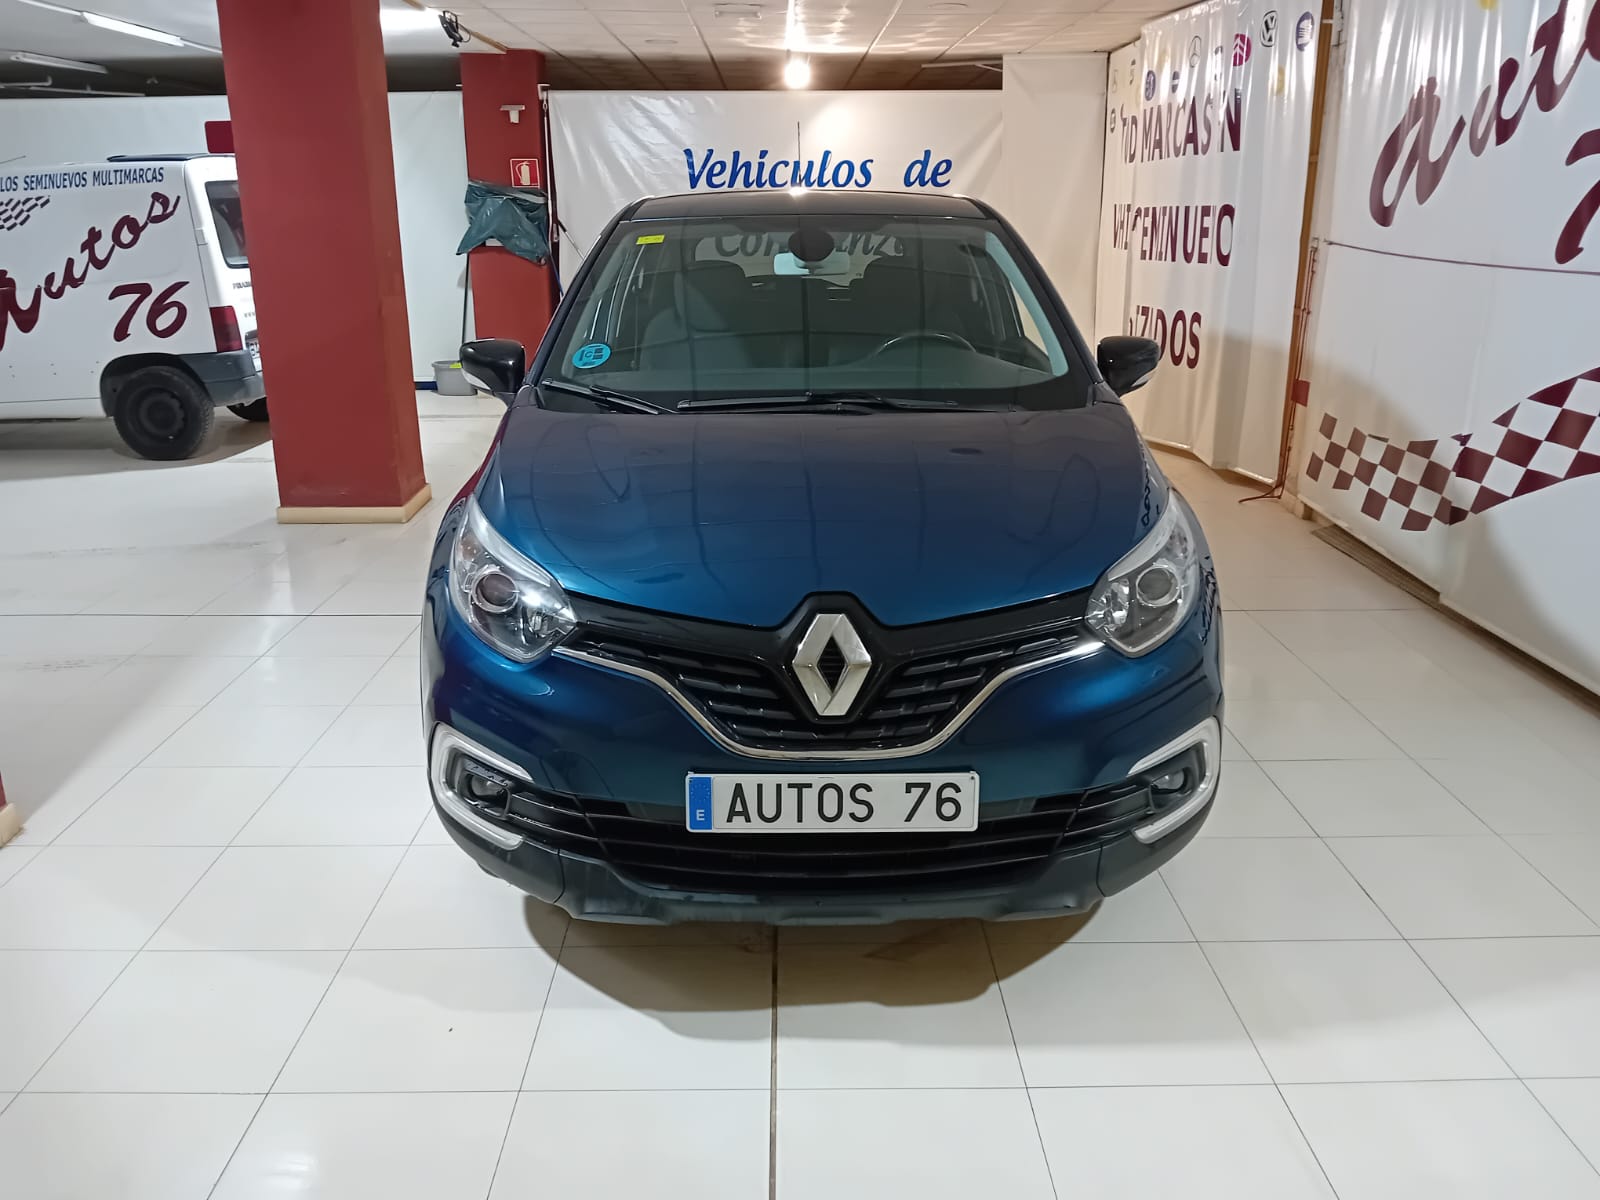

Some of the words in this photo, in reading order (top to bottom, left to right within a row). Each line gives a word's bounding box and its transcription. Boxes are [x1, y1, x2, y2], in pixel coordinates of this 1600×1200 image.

[1369, 0, 1600, 227] Aut
[23, 171, 88, 191] SEMINUEVOS
[92, 167, 165, 187] MULTIMARCAS
[683, 148, 874, 190] Vehículos
[903, 149, 953, 188] de
[108, 280, 190, 342] 76
[696, 809, 705, 821] E
[726, 782, 875, 824] AUTOS
[903, 782, 963, 823] 76
